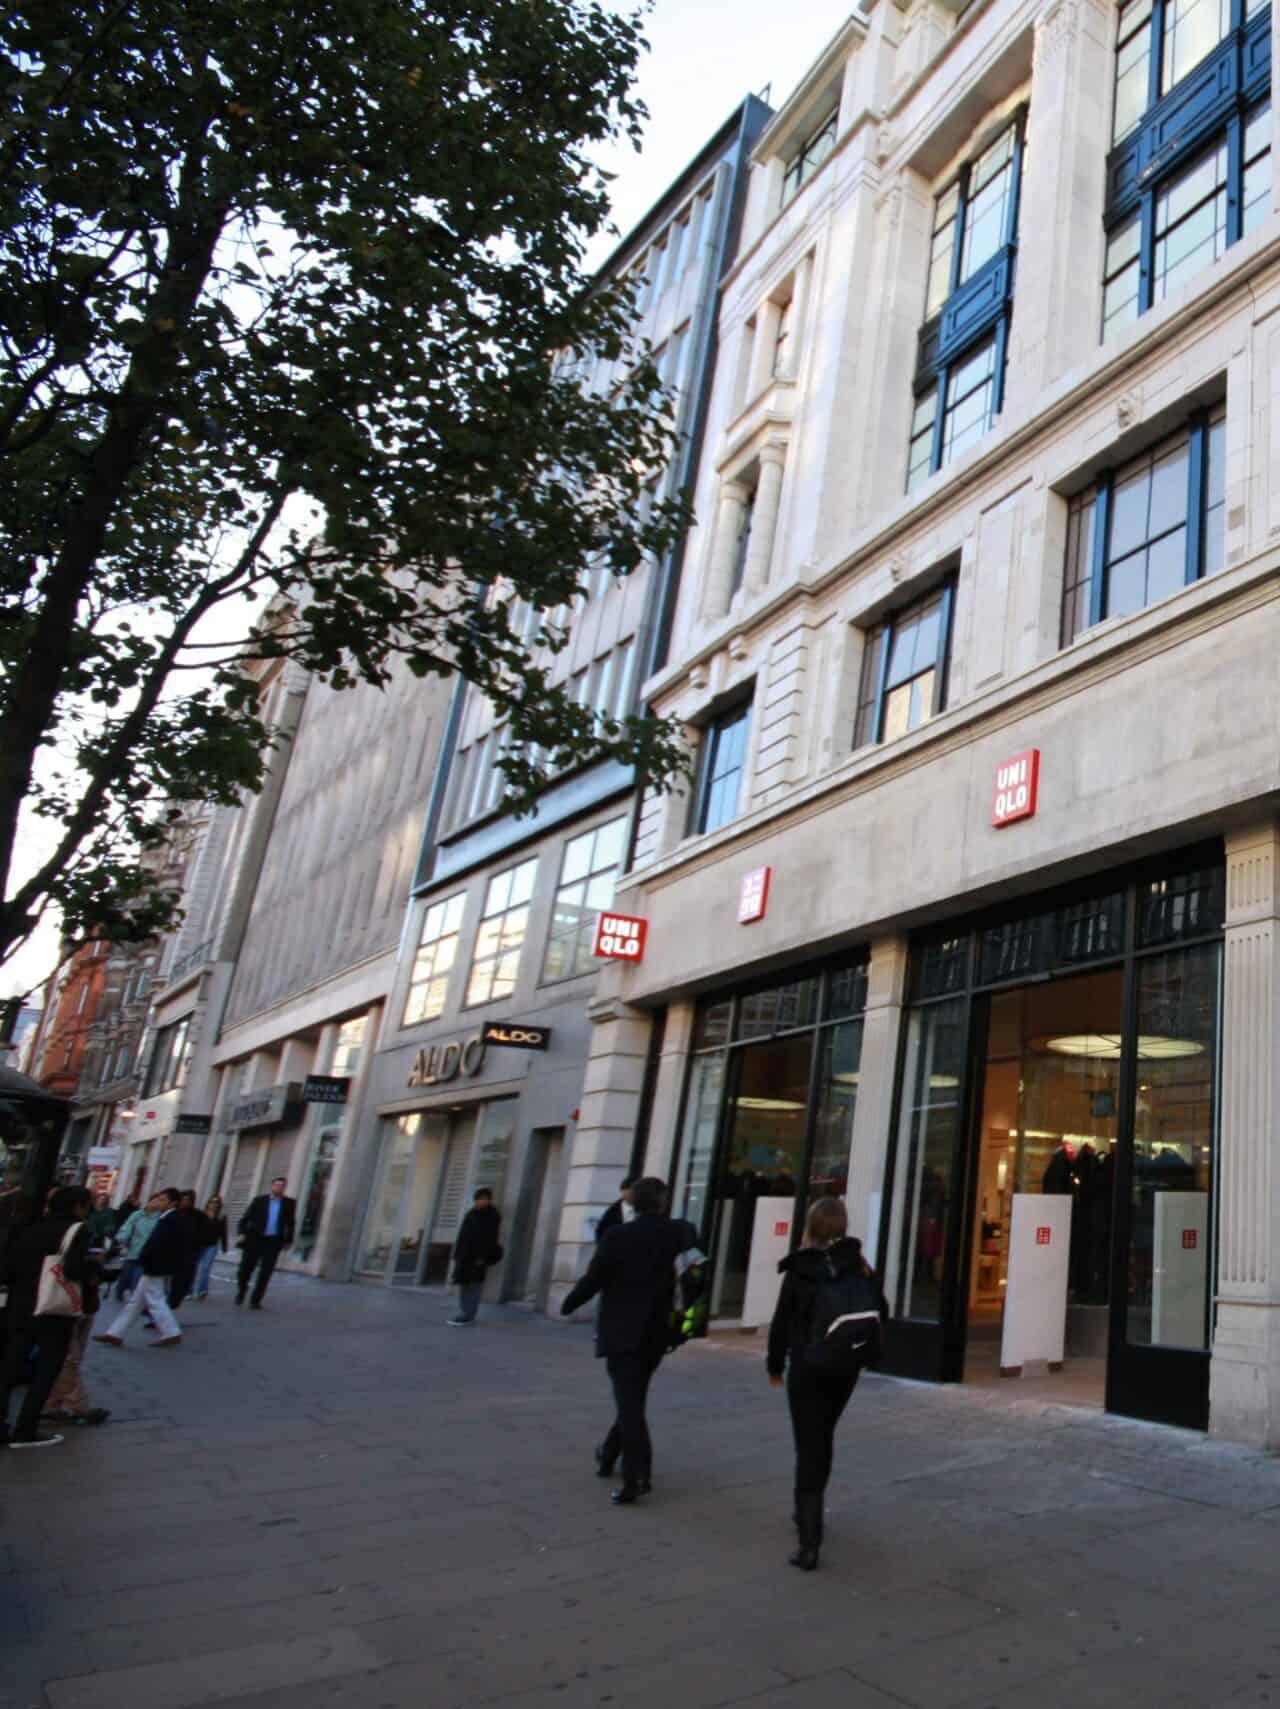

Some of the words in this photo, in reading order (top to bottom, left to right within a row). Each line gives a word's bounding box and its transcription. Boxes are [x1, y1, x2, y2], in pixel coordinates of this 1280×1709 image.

[997, 759, 1027, 790] UNI
[995, 785, 1028, 819] QLO
[602, 917, 640, 938] UNI
[599, 935, 640, 956] QLO
[487, 1028, 543, 1044] ALDO
[407, 1035, 488, 1089] ALDO
